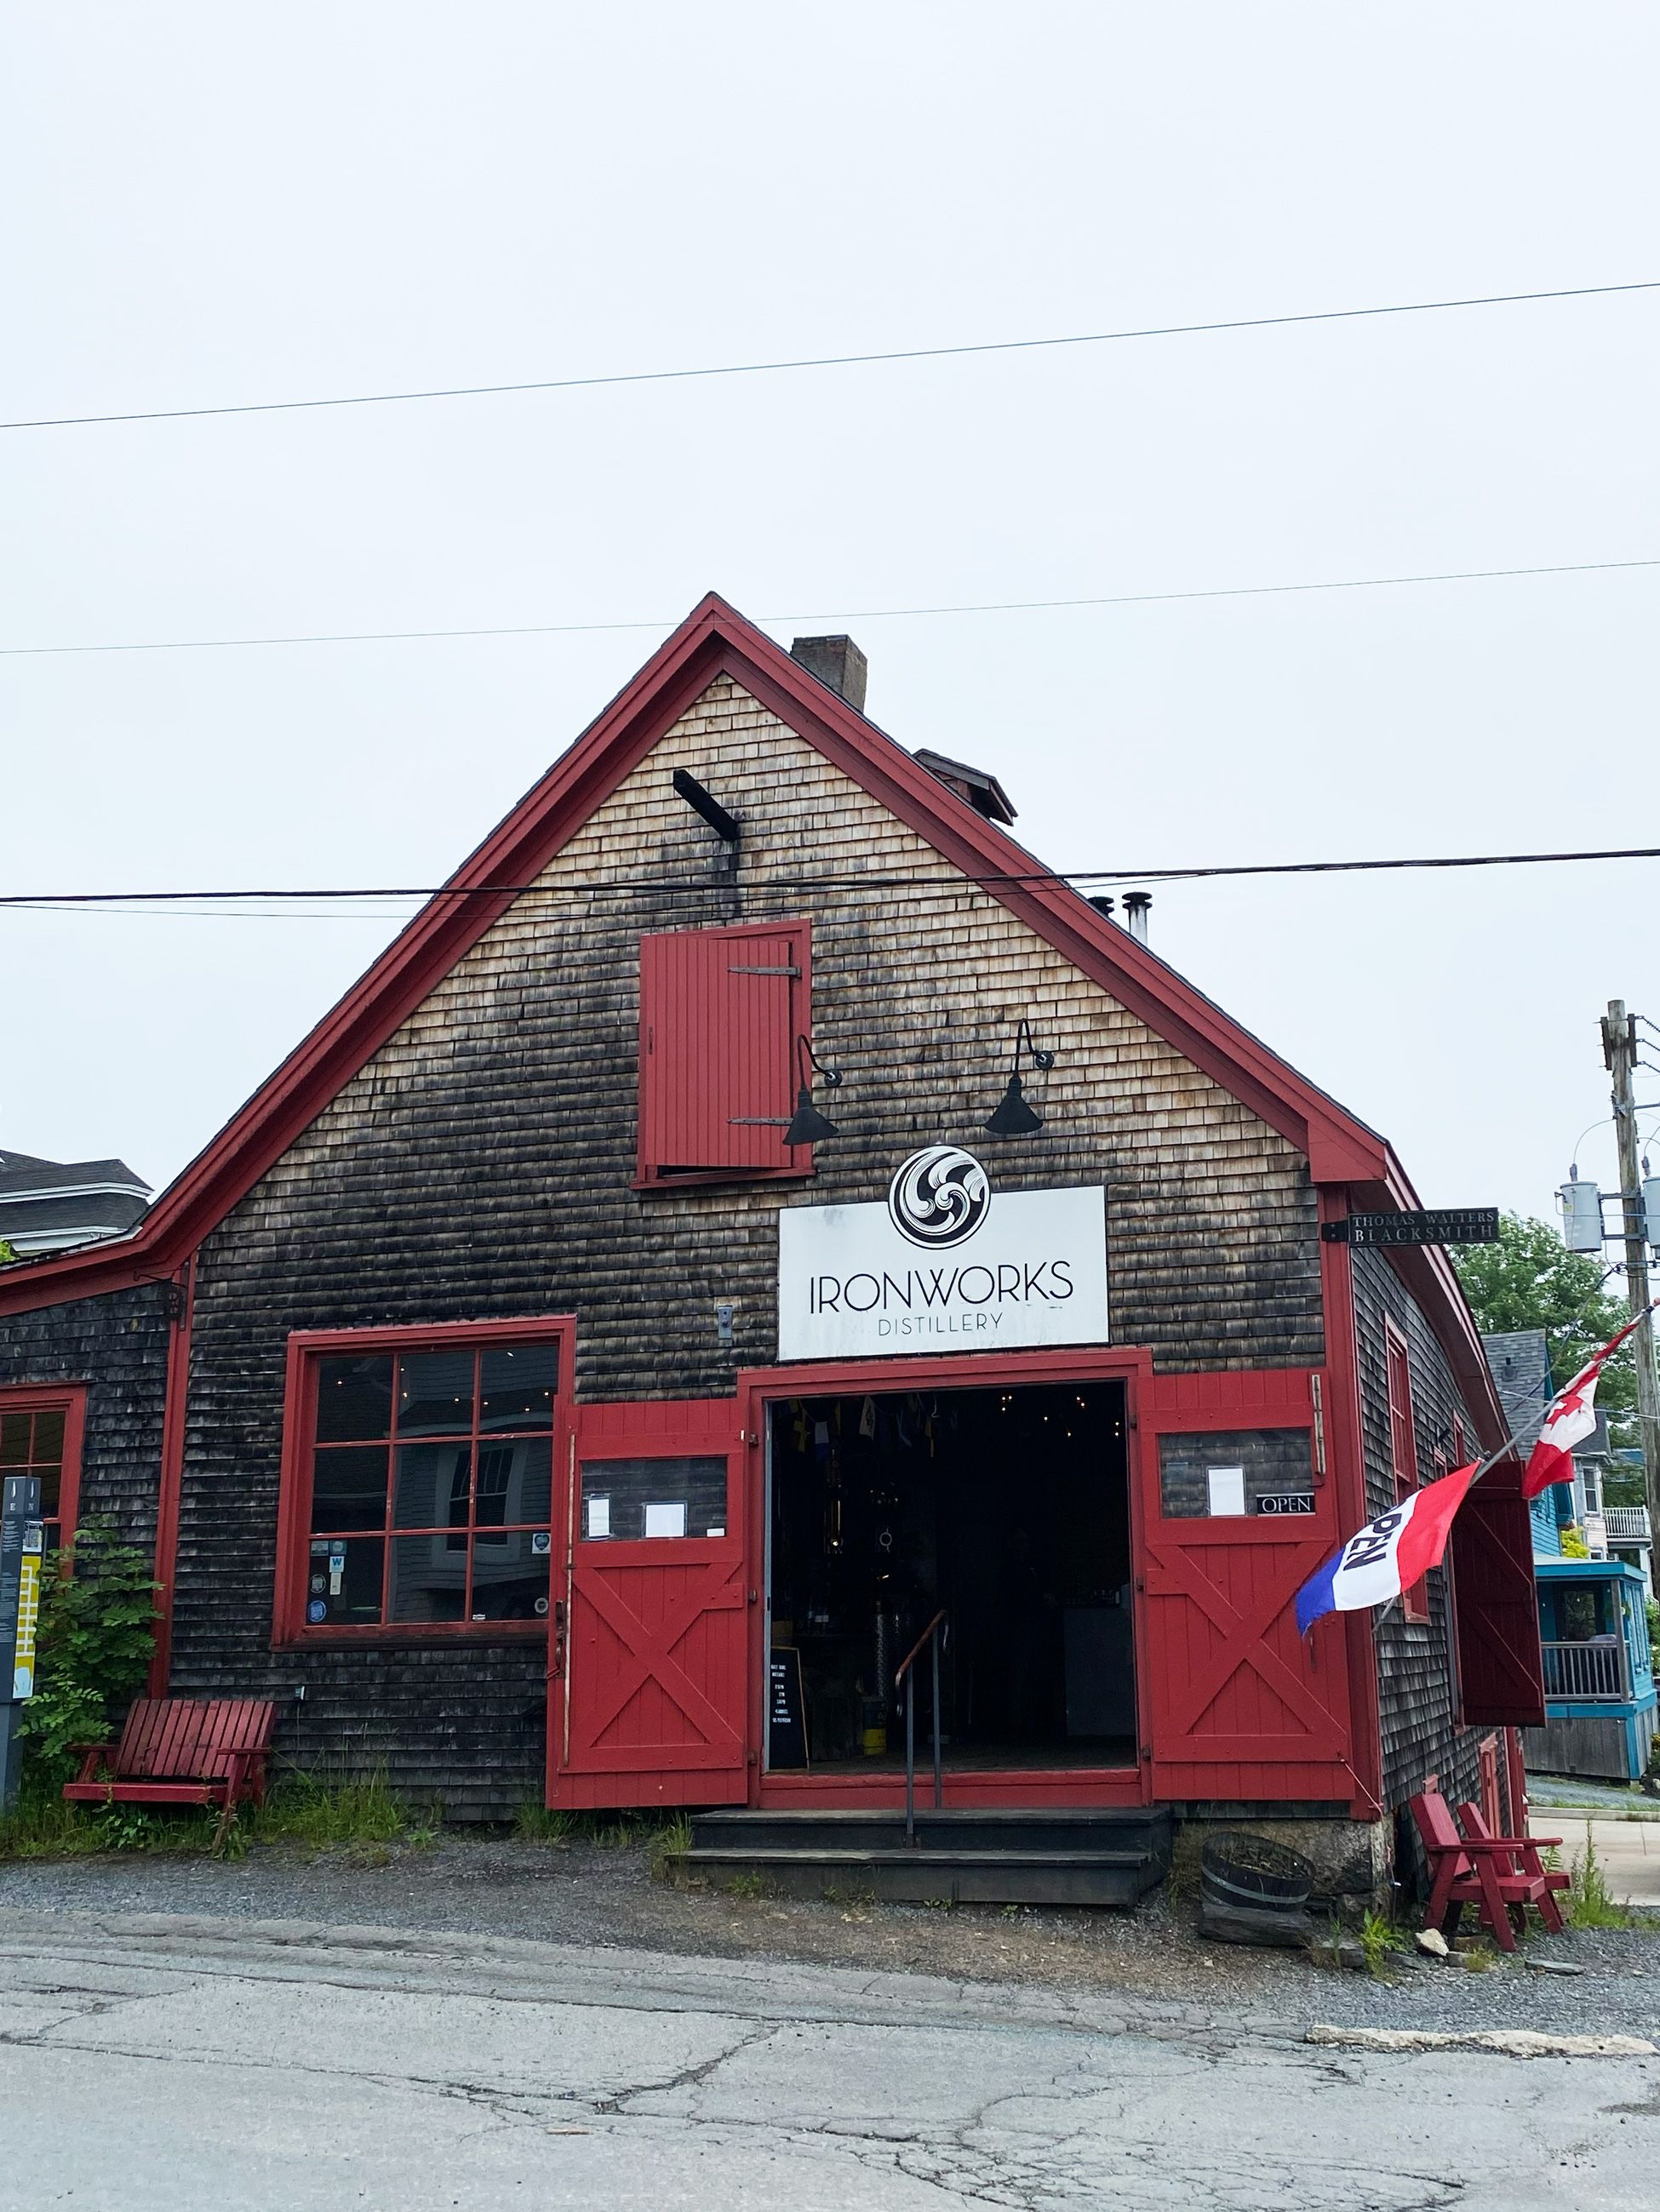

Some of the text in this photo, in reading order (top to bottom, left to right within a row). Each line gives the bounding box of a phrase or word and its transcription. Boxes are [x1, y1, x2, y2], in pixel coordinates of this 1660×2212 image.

[1353, 1212, 1495, 1227] THOMAS WALTERS
[1355, 1225, 1492, 1243] BLACKSMITH
[810, 1260, 1073, 1314] IRONWORKS
[879, 1312, 1004, 1336] DISTILLERY
[9, 1502, 16, 1511] E
[1262, 1497, 1311, 1512] OPEN
[1343, 1505, 1405, 1571] PEN
